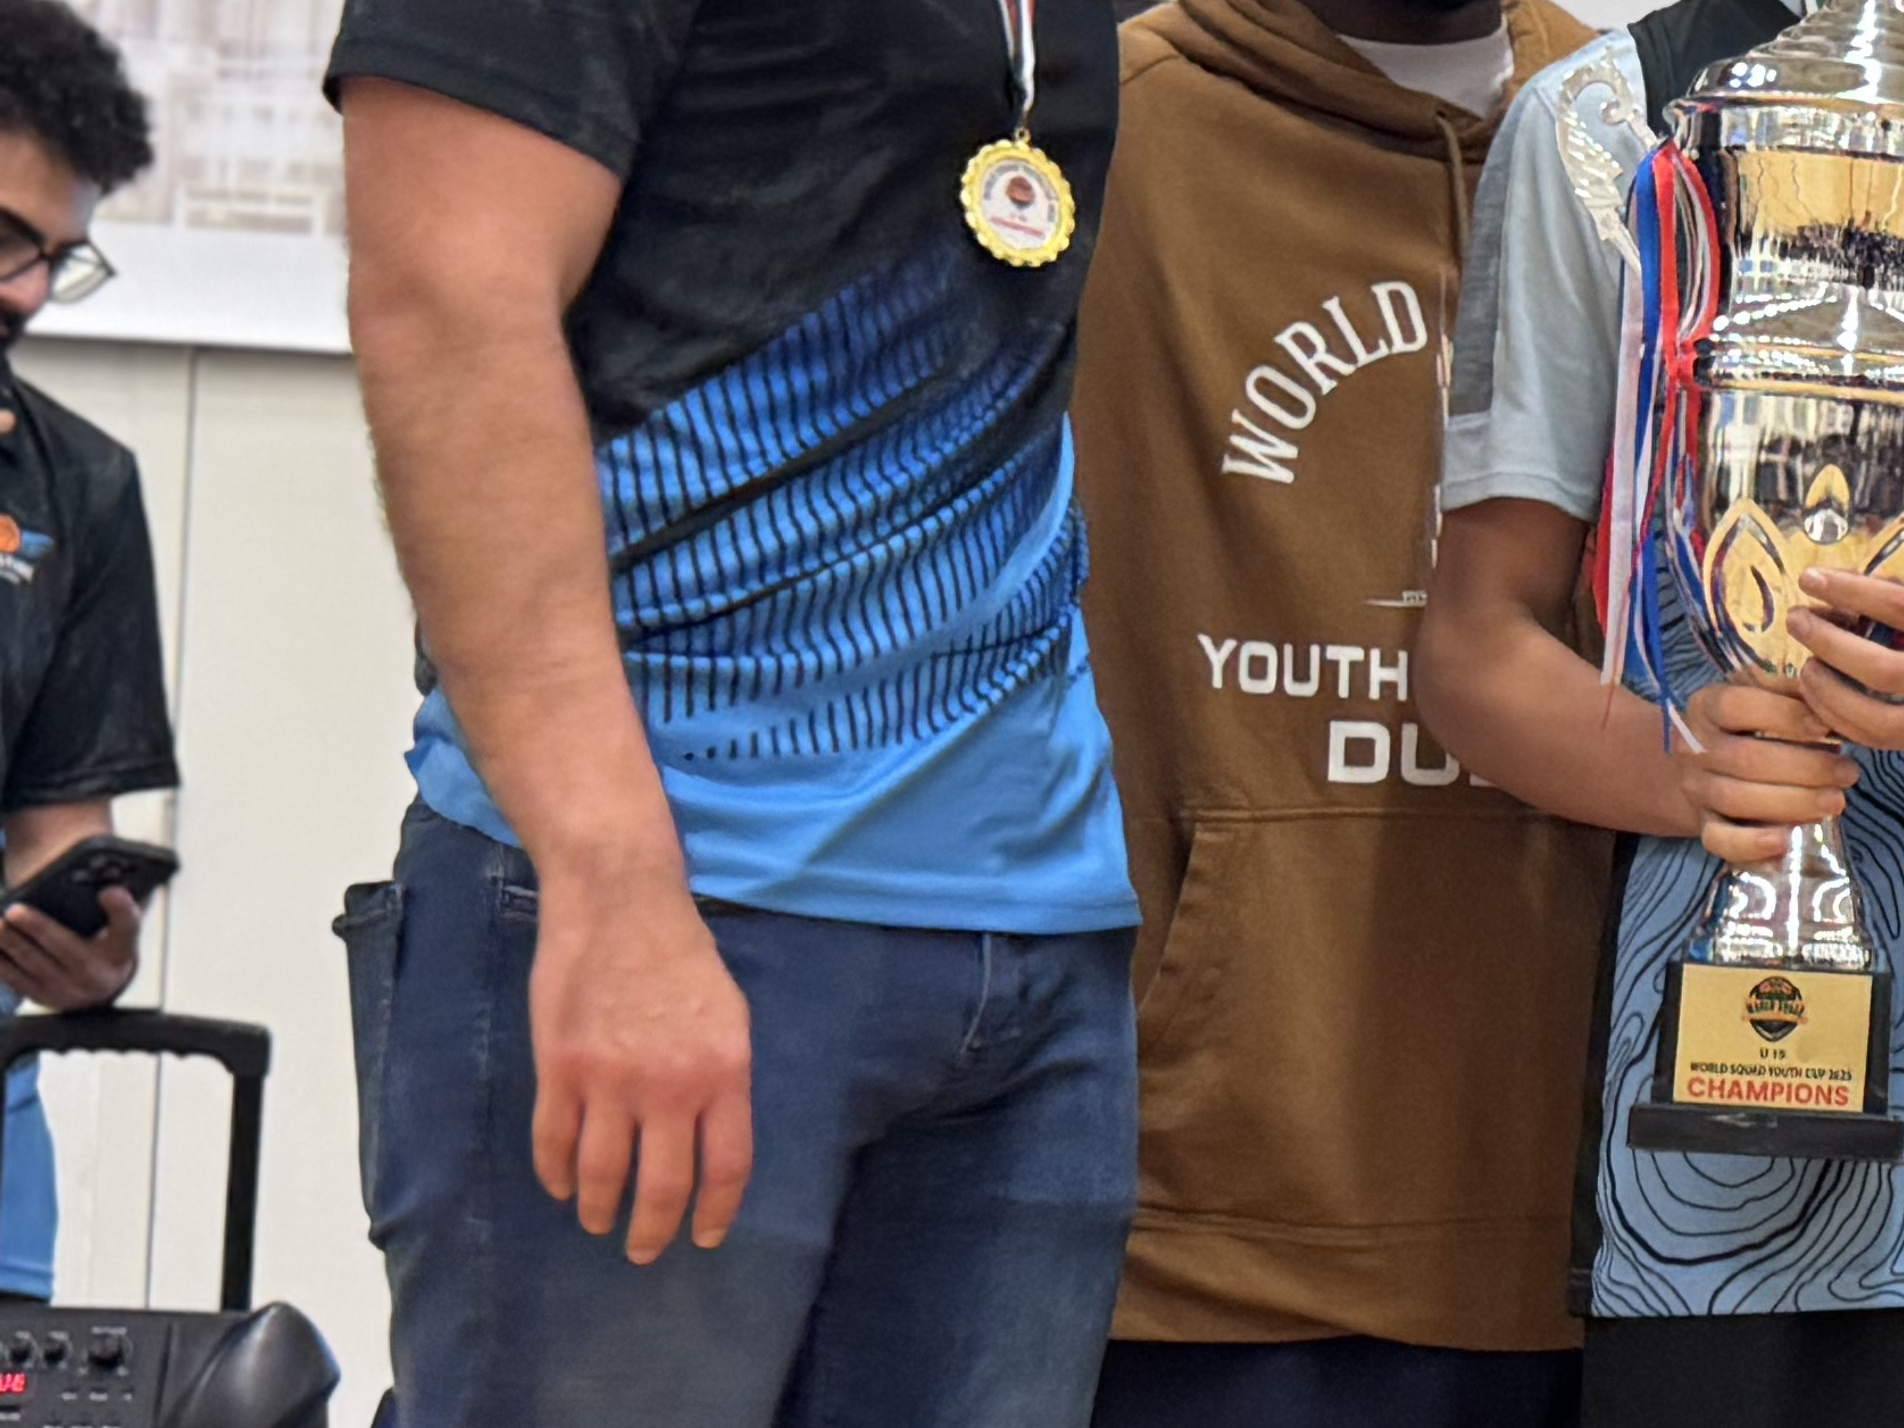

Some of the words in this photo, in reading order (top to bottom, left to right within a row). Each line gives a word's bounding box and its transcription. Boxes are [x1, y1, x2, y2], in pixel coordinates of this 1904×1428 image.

[1222, 280, 1428, 484] WORLD
[1197, 632, 1408, 702] YOUTH
[1687, 1075, 1850, 1107] CHAMPIONS
